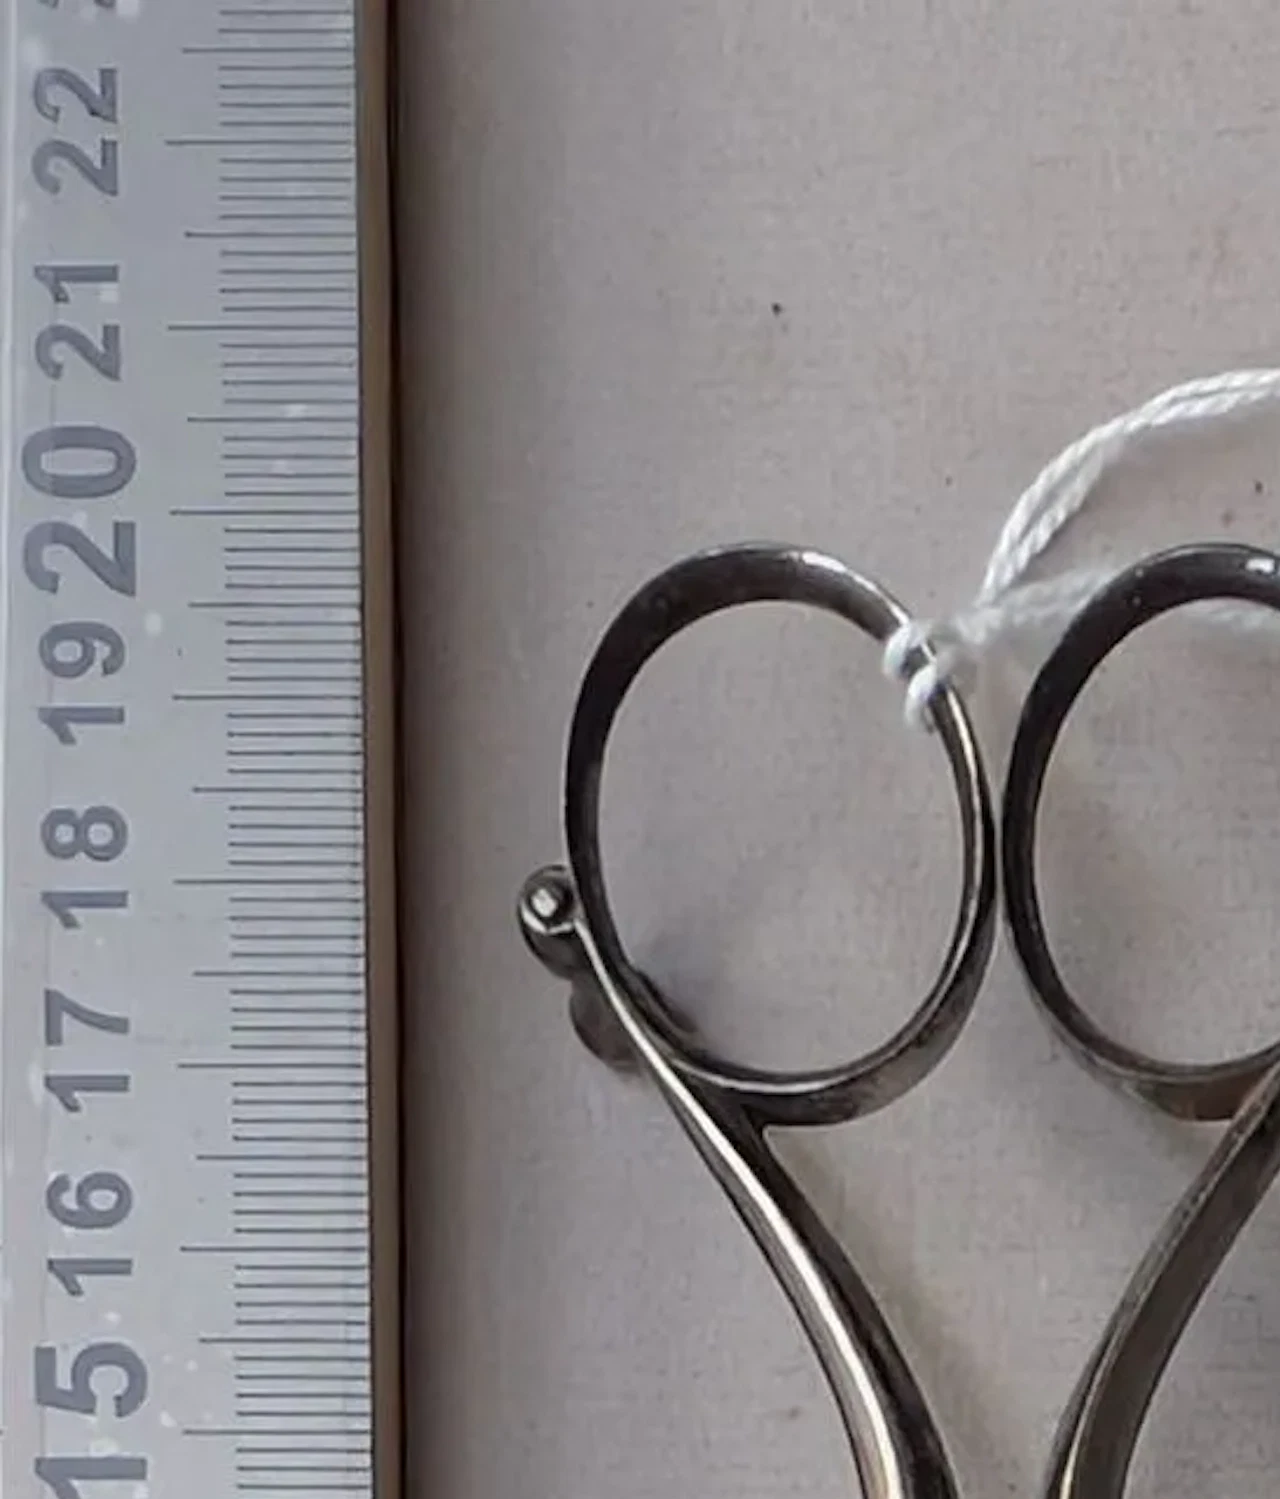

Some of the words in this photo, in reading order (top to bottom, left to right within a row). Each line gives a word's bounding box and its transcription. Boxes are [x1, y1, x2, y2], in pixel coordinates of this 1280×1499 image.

[32, 68, 118, 196] 22
[34, 265, 120, 382] 21
[22, 426, 137, 598] 20
[38, 621, 125, 746] 19
[40, 805, 128, 930] 18
[43, 988, 130, 1113] 17
[46, 1172, 133, 1297] 16
